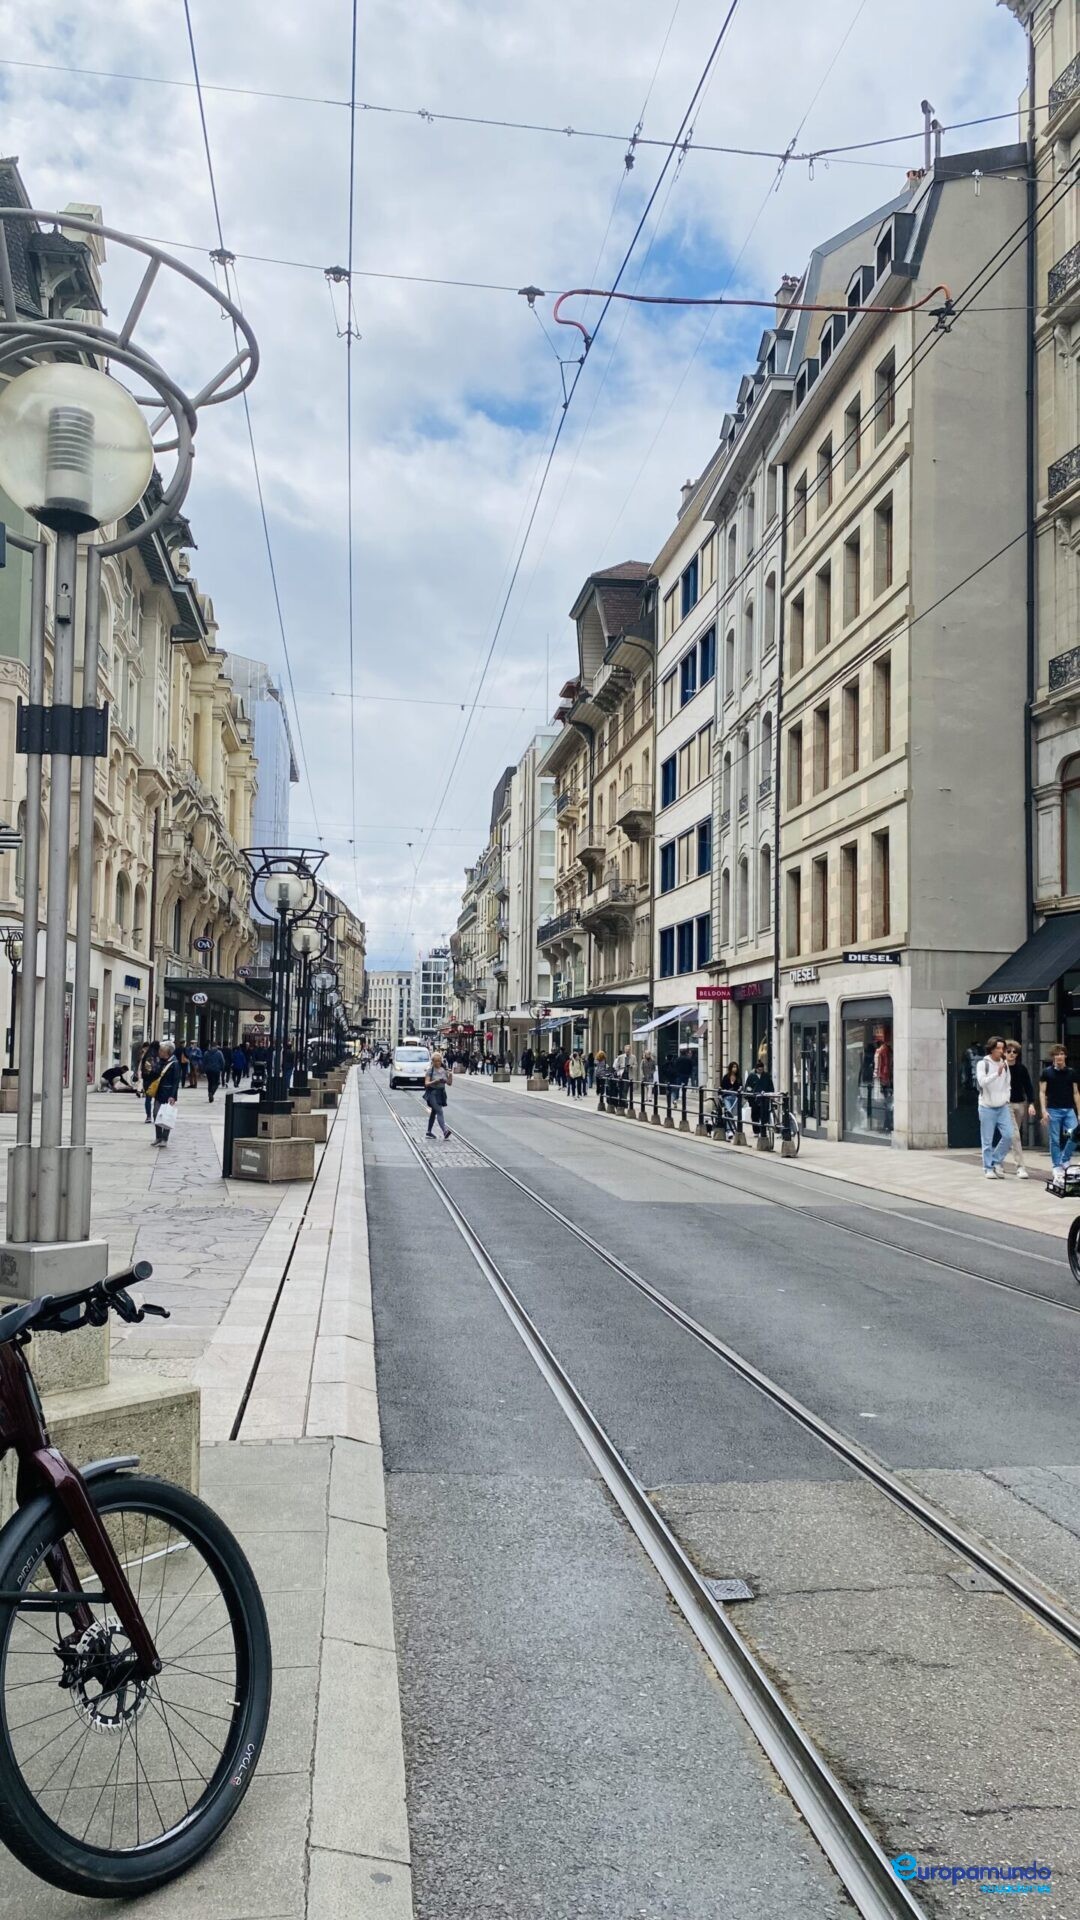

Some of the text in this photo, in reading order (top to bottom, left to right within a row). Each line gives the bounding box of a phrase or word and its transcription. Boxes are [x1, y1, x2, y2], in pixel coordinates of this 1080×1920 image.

[848, 954, 893, 962] DIESEL
[789, 967, 816, 983] DIESEL
[998, 992, 1027, 1003] WESTON
[17, 1541, 44, 1586] PIRELLI
